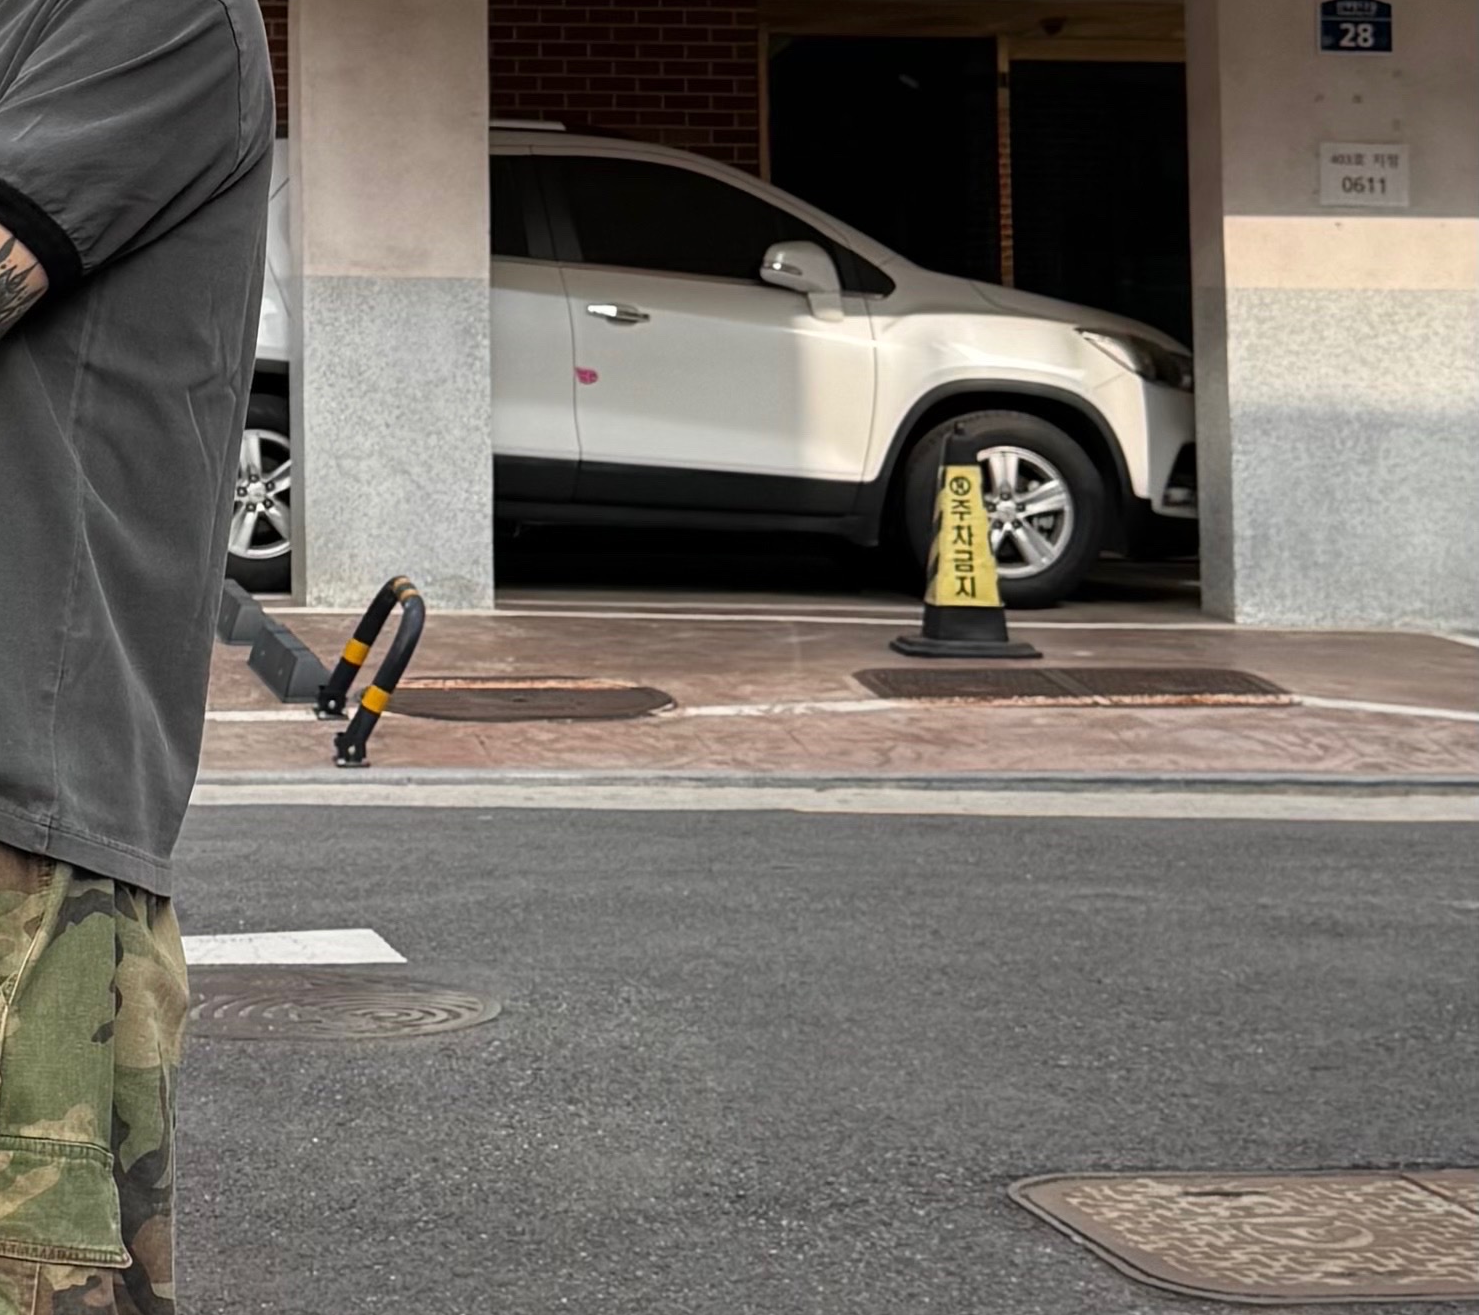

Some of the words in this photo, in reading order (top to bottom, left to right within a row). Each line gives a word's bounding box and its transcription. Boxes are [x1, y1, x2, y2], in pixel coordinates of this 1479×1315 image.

[1339, 23, 1374, 47] 28
[1342, 176, 1386, 194] 0611
[951, 498, 977, 598] 주차금지
